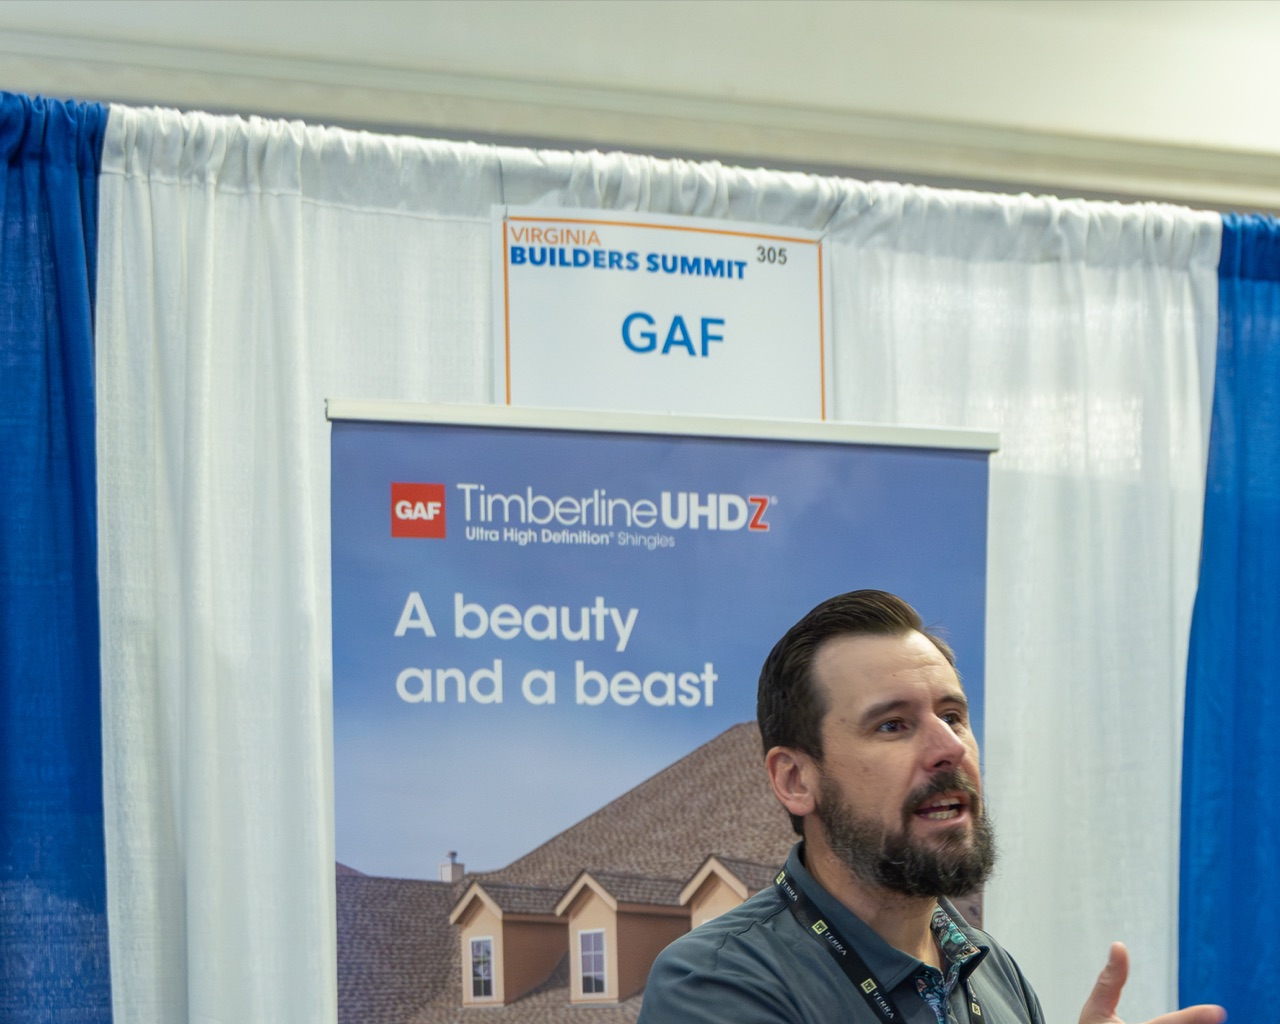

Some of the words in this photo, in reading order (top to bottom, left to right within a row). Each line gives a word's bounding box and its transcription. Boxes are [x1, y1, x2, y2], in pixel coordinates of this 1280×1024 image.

[510, 226, 601, 246] VIRGINIA
[510, 246, 640, 272] BUILDERS
[646, 253, 748, 279] SUMMIT
[756, 246, 788, 265] 305
[621, 312, 726, 358] GAF
[395, 501, 442, 521] GAF
[465, 526, 500, 543] Ultra
[503, 527, 538, 546] High
[618, 532, 676, 550] Shingles
[394, 591, 437, 638] A
[454, 592, 639, 652] beauty
[395, 659, 503, 704] and
[521, 668, 556, 705] a
[575, 660, 719, 707] beast
[825, 931, 848, 956] TERRA
[873, 991, 895, 1019] TERRA
